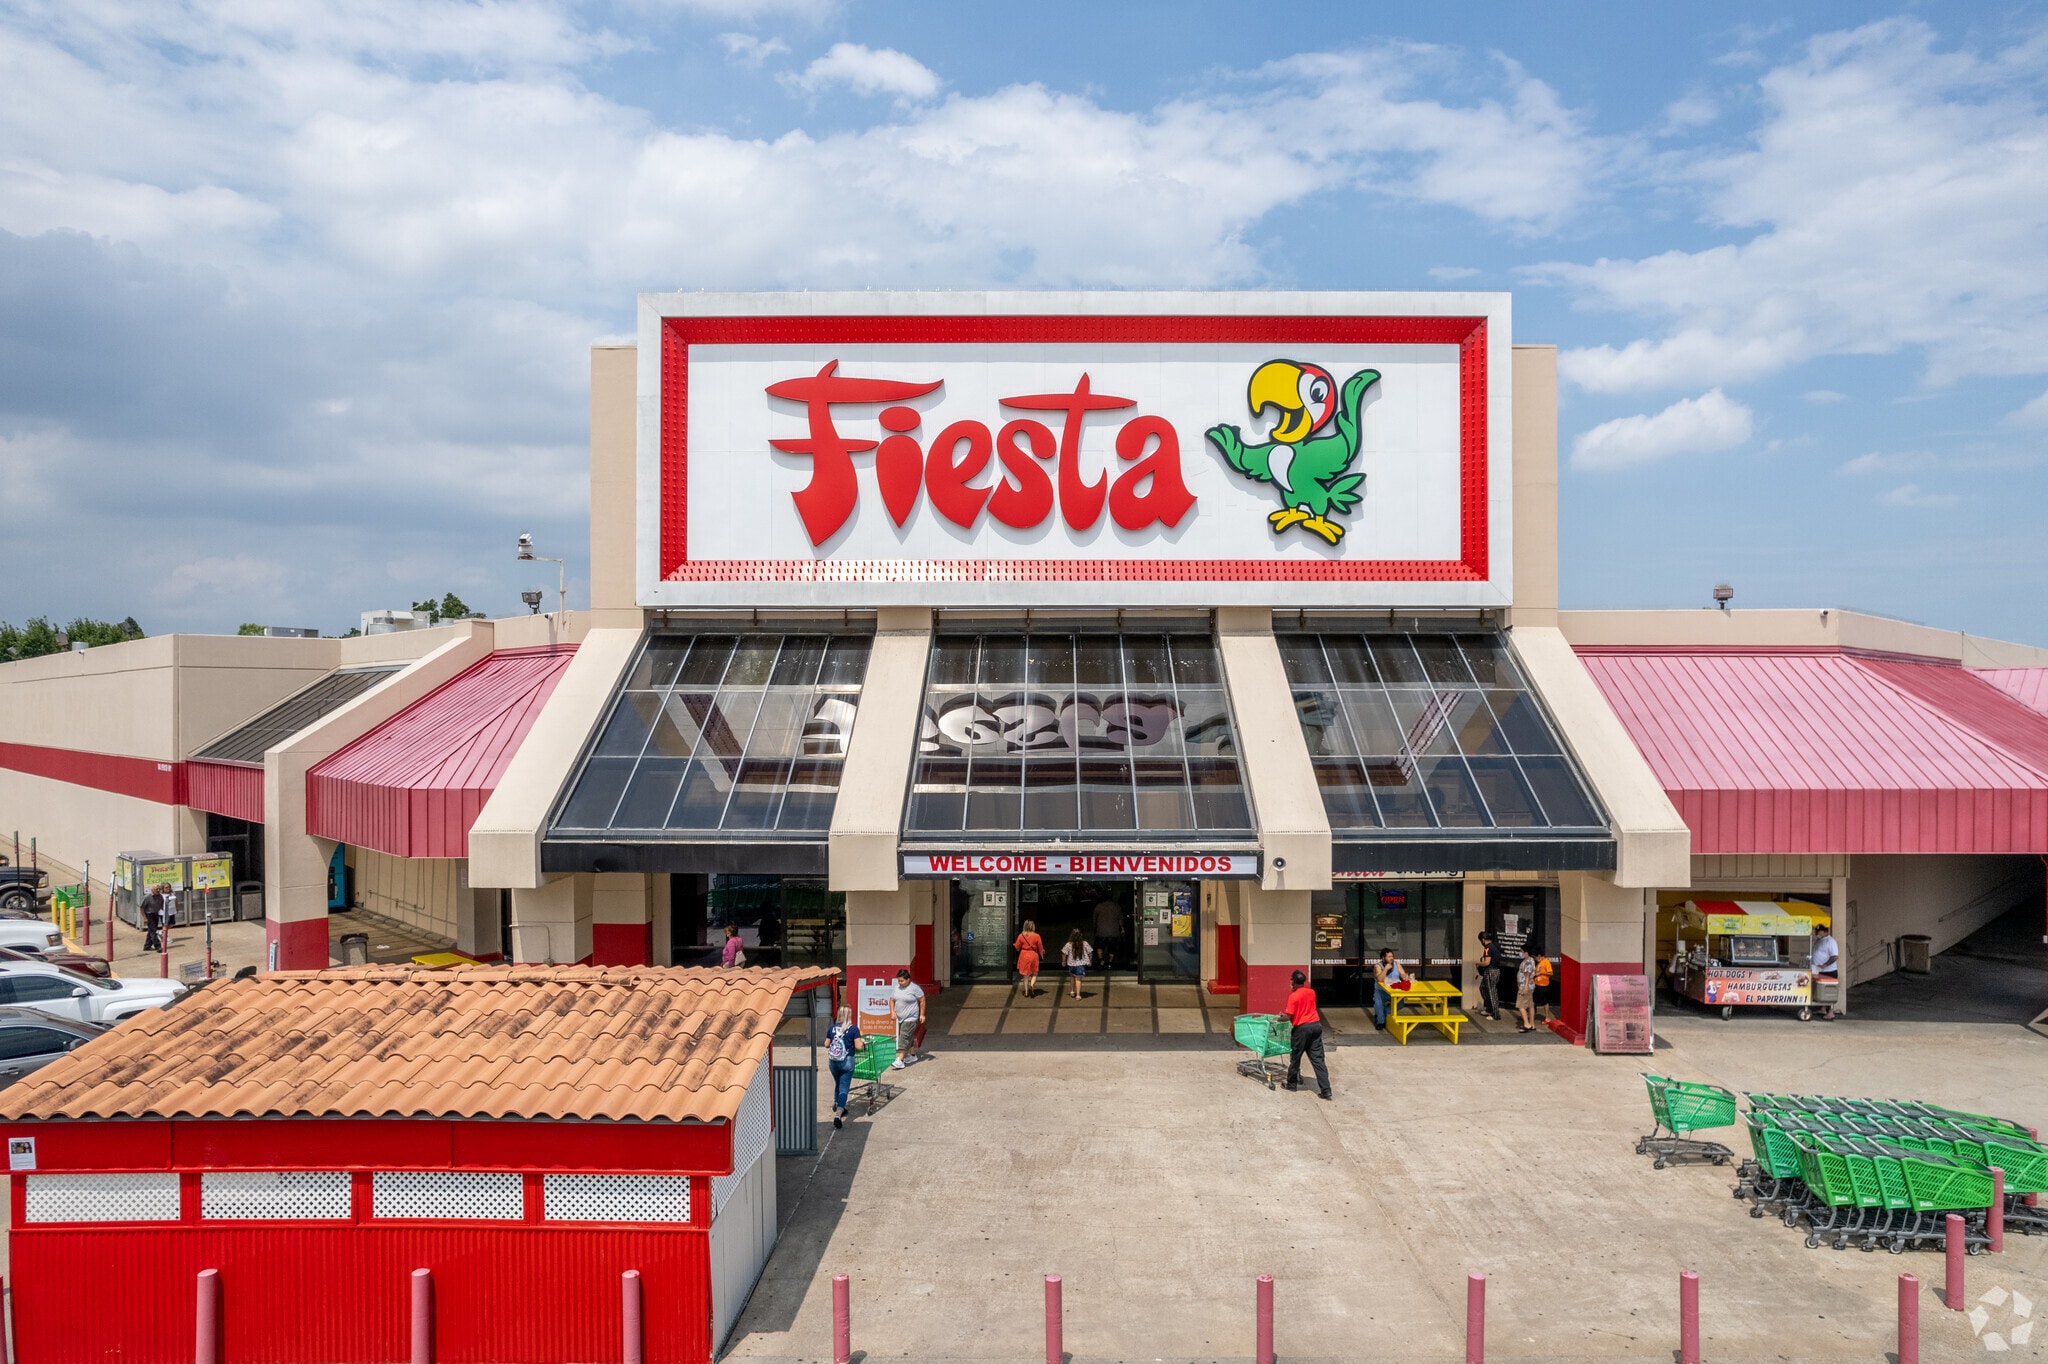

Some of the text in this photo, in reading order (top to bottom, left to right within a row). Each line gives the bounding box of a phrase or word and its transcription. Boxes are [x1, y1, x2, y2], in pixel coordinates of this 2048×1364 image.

[764, 358, 1198, 548] Fiesta
[929, 855, 1047, 873] WELCOME
[1069, 854, 1232, 873] BIENVENIDOS
[1380, 895, 1405, 905] OPEN
[1708, 970, 1753, 979] HOT DOGS Y
[1727, 982, 1793, 992] HAMBURGUESAS
[1745, 995, 1755, 1003] EL
